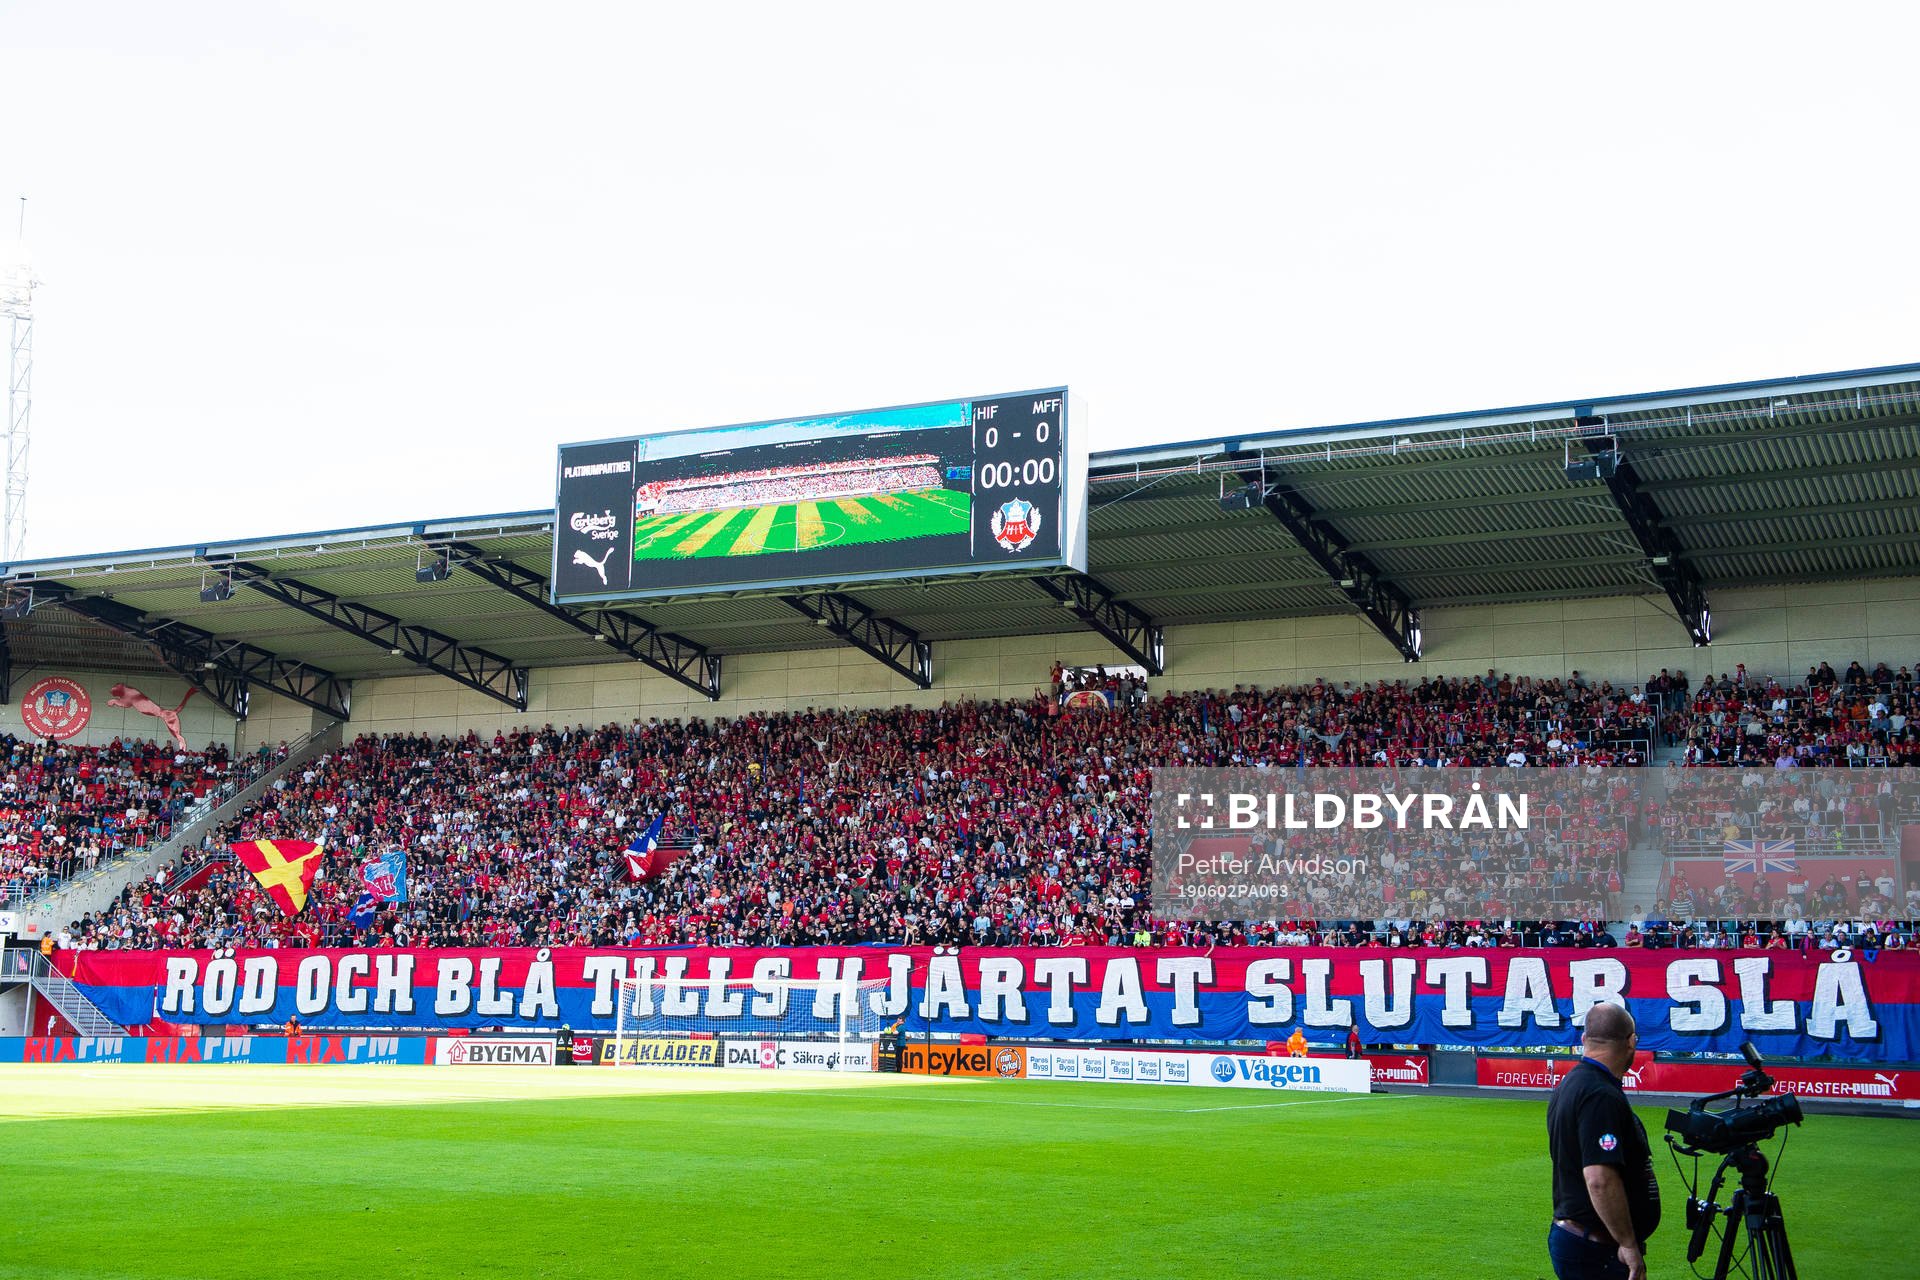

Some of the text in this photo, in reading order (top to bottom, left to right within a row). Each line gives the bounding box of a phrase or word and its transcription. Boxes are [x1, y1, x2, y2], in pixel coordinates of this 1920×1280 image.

[977, 405, 998, 420] HIF
[1032, 399, 1060, 415] MFF
[985, 427, 998, 448] 0
[1036, 421, 1049, 443] 0
[564, 461, 631, 479] PLATINUMPARTNER
[981, 457, 1055, 489] 00:00
[570, 510, 616, 534] Carlsberg
[591, 529, 619, 541] Sverige
[162, 946, 1879, 1039] RÖD OCH BLÅ TILLS HJÄRTAT SLUTAR SLÅ
[469, 1045, 547, 1063] BYGMA
[793, 1051, 824, 1064] Säkra
[928, 1048, 991, 1075] cykel
[1033, 1063, 1049, 1072] Bygg
[1083, 1058, 1102, 1066] Paras
[1110, 1059, 1130, 1067] Paras
[1138, 1060, 1158, 1068] Paras
[1165, 1061, 1185, 1069] Paras
[1059, 1064, 1075, 1073] Bygg
[1085, 1065, 1102, 1074] Bygg
[1113, 1066, 1130, 1075] Bygg
[1140, 1067, 1157, 1076] Bygg
[1168, 1068, 1185, 1078] Bygg
[1237, 1058, 1321, 1088] Vågen
